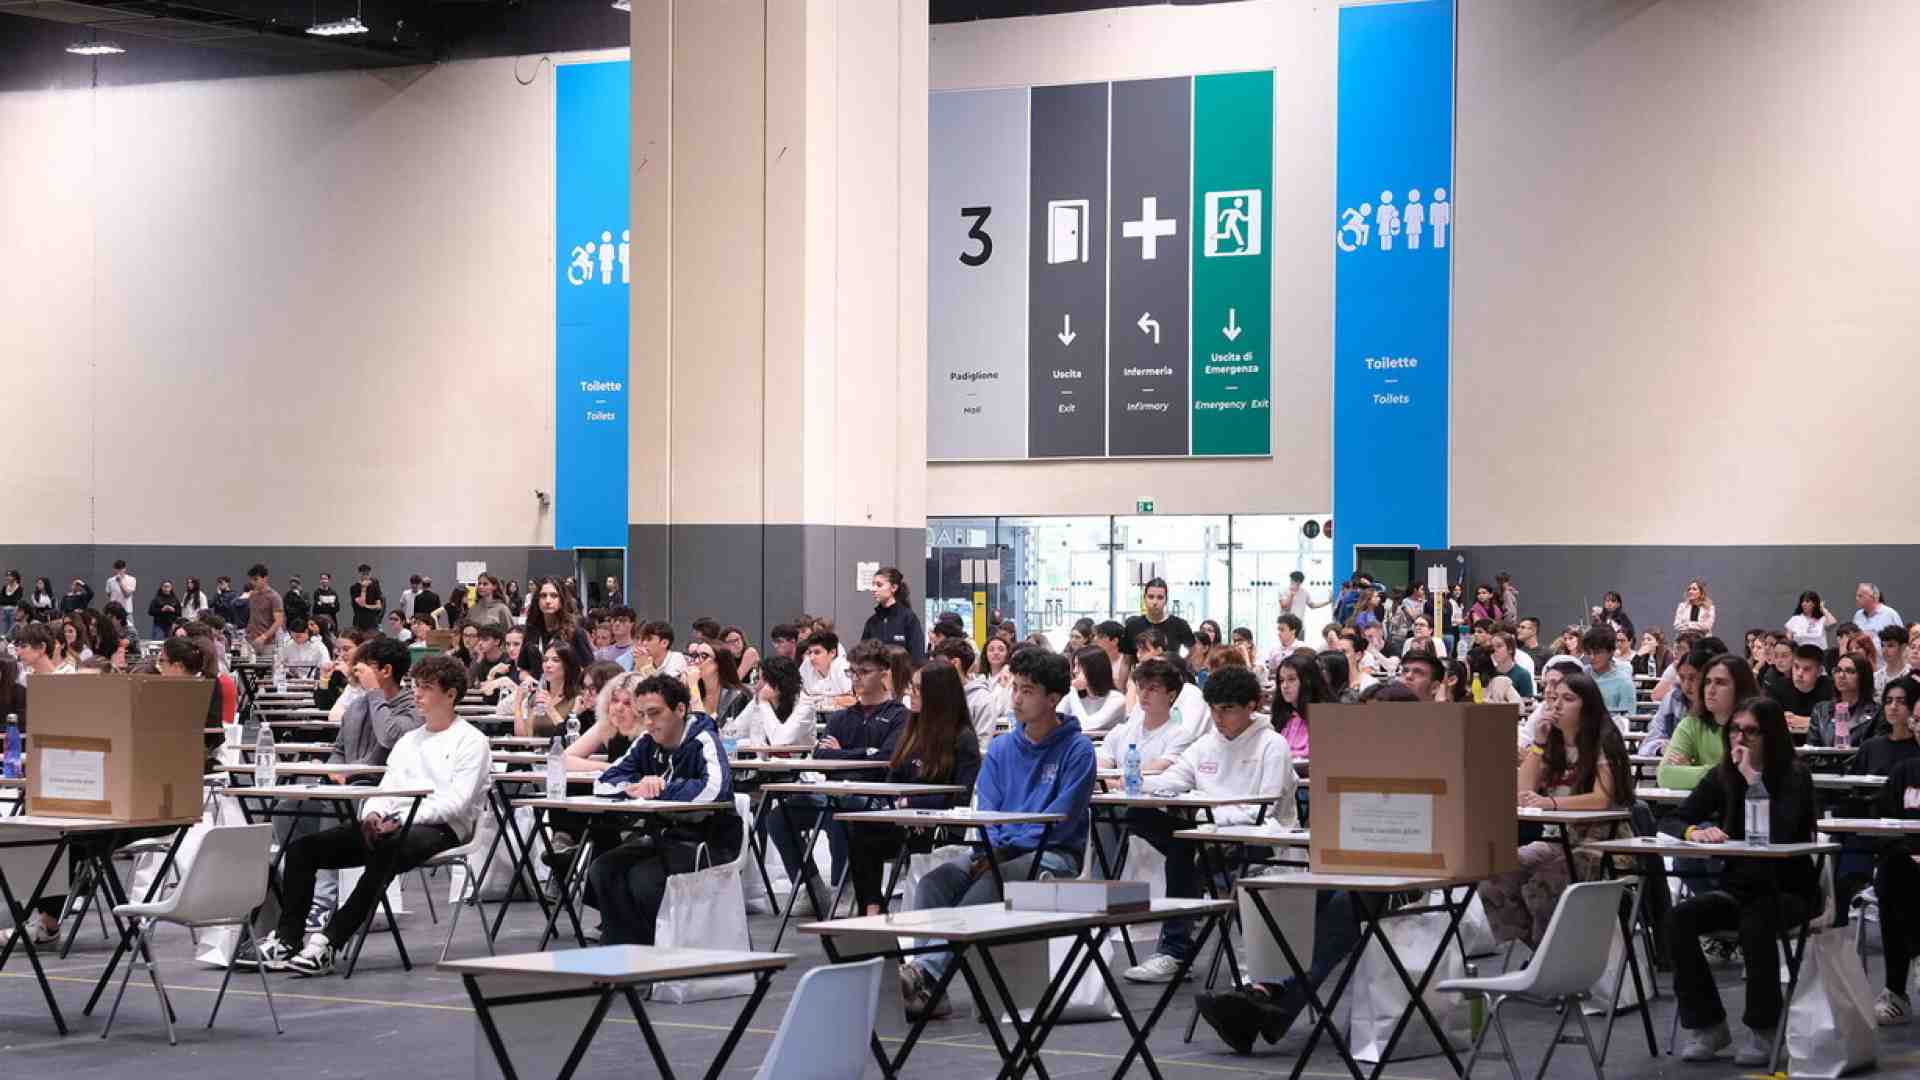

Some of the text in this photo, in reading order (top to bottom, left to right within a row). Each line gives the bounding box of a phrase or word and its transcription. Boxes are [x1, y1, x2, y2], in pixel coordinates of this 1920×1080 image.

[959, 206, 993, 266] 3
[1211, 352, 1253, 362] Uscita di
[1364, 356, 1418, 369] Toilette
[1052, 369, 1082, 379] Uscita
[1123, 366, 1173, 376] Infermeria
[1205, 364, 1259, 375] Emergenza
[950, 370, 999, 382] Padiglione
[580, 380, 622, 392] Toilette
[1372, 393, 1410, 405] Toilets
[1058, 403, 1076, 413] Exit
[1127, 401, 1169, 412] Infirmary
[1195, 399, 1270, 411] Emergency Exit
[586, 411, 616, 421] Toilets
